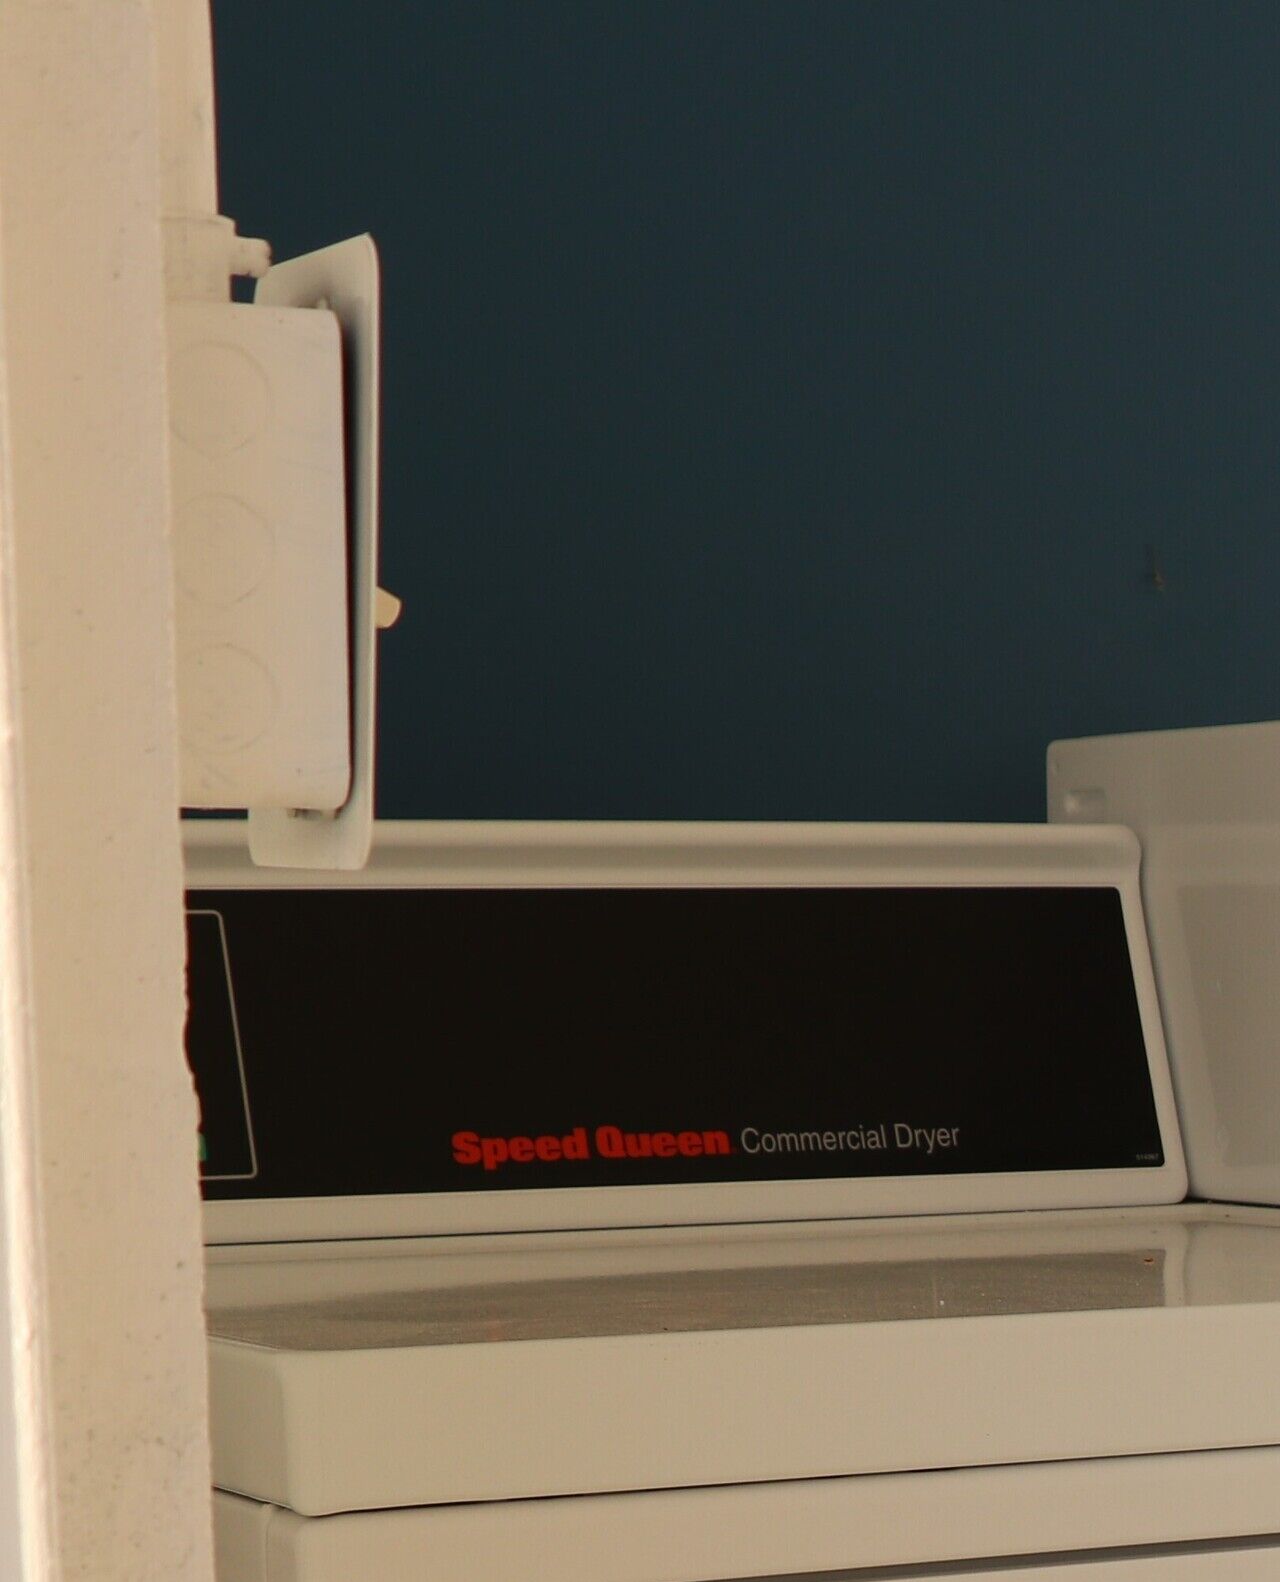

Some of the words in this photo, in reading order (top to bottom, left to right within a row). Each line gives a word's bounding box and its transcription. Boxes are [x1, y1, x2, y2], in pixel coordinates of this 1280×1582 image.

[452, 1127, 589, 1171] Speed
[595, 1125, 731, 1158] Queen
[741, 1124, 887, 1154] Commercial
[894, 1123, 960, 1154] Dryer
